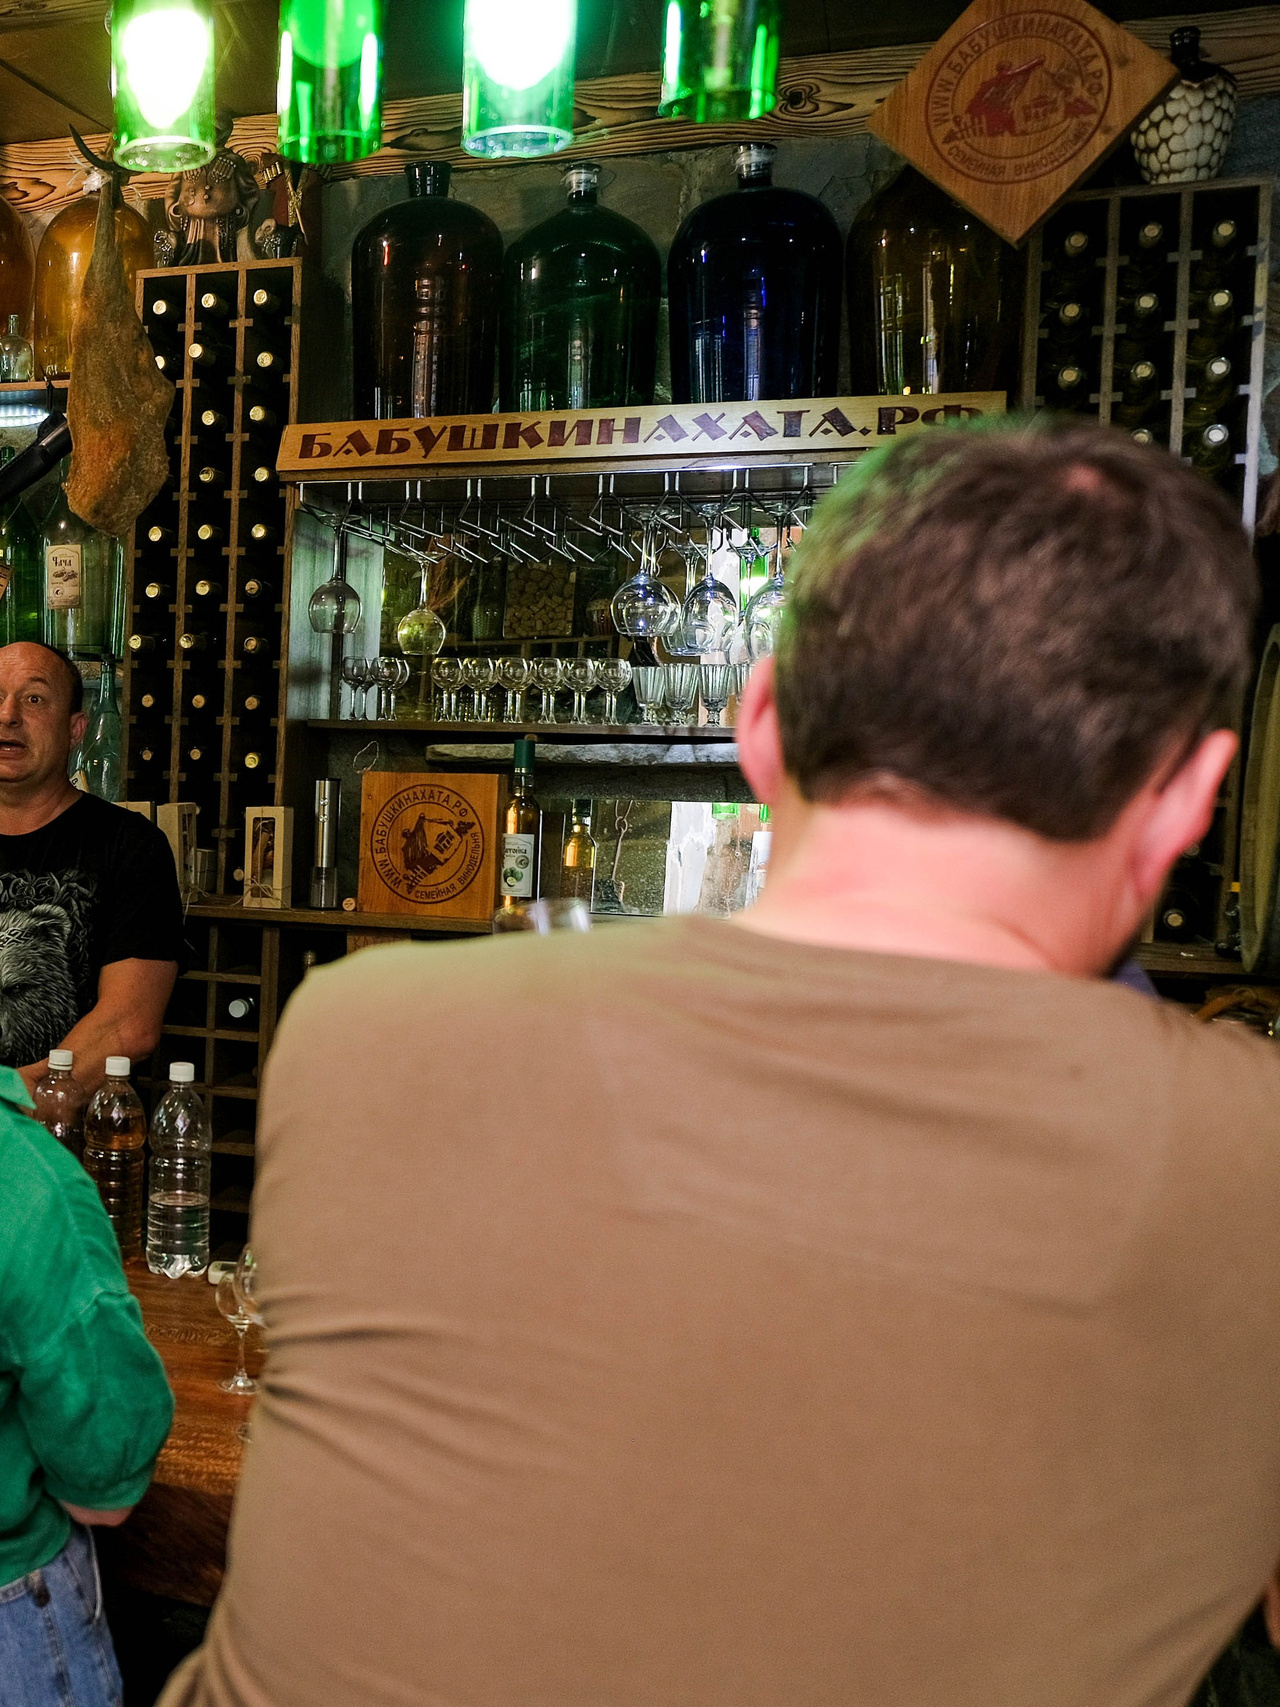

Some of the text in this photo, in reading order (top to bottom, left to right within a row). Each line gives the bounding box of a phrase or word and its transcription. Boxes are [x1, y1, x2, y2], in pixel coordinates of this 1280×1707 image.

[298, 404, 984, 460] БАБУШКИНАХАТА.РФ
[375, 789, 468, 889] WWW.БАБУШКИНАХАТА.РФ
[414, 831, 480, 900] СЕМЕЙНАЯ ВИНОДЕЛЬНЯ
